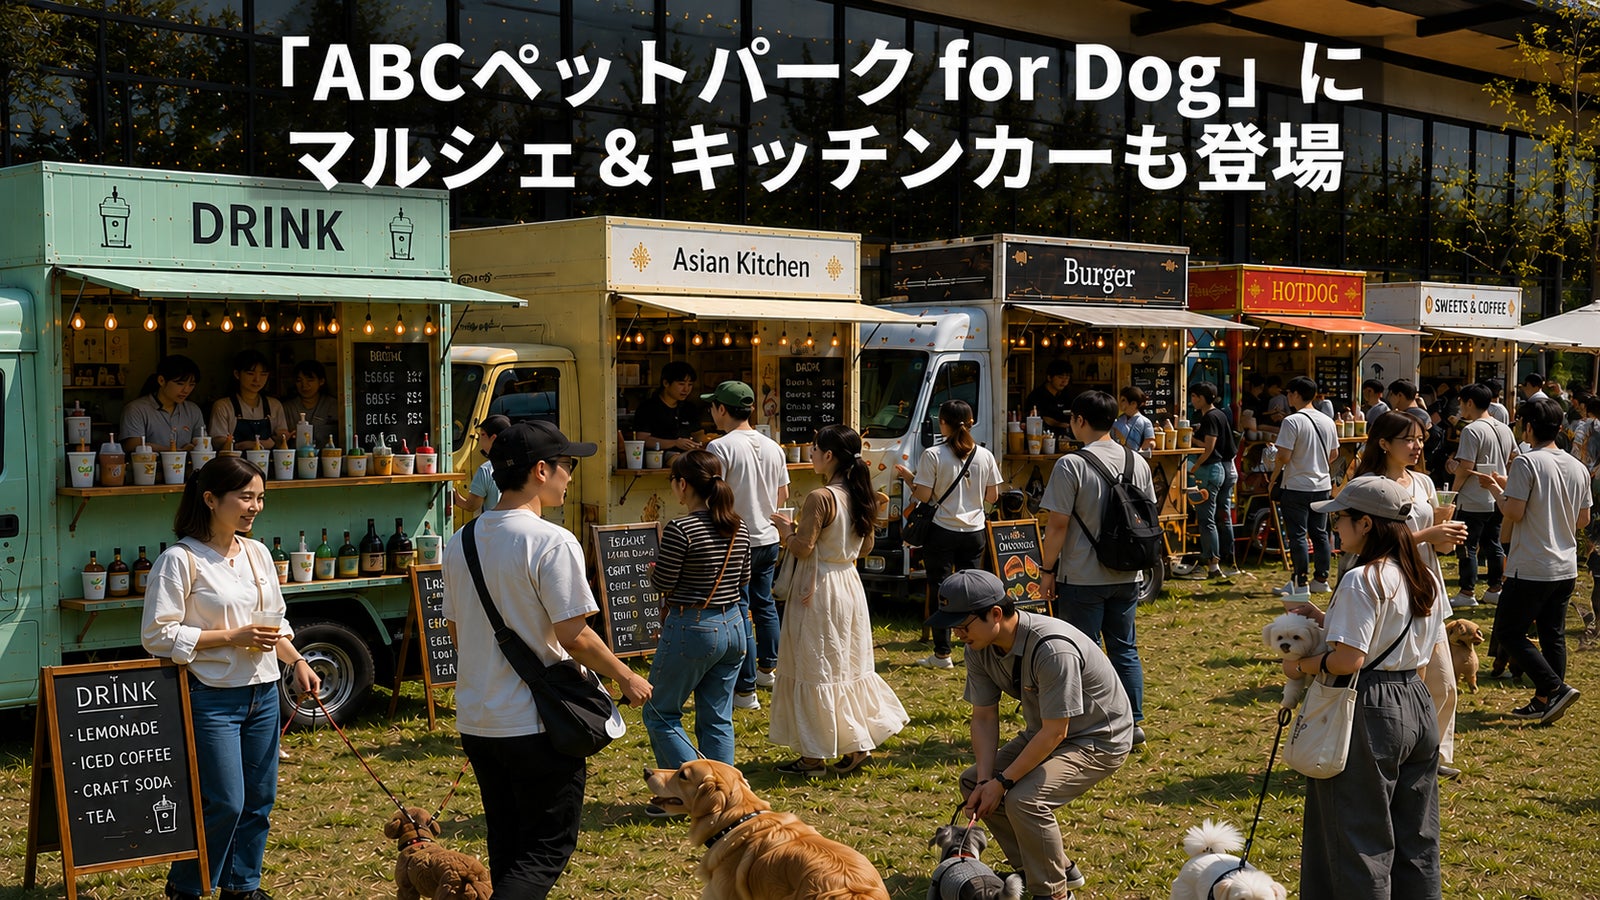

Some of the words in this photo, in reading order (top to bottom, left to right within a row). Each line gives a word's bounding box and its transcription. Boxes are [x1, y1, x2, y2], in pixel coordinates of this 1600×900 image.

[192, 202, 345, 252] DRINK
[673, 246, 729, 274] Asian
[737, 251, 810, 278] Kitchen
[1063, 257, 1136, 294] Burger
[1272, 280, 1339, 304] HOTDOG
[1434, 298, 1468, 314] SWEETS
[1469, 300, 1476, 314] &
[1478, 300, 1507, 315] COFFEE
[76, 680, 158, 708] DRINK
[77, 720, 159, 742] LEMONADE
[80, 753, 115, 770] ICED
[119, 747, 172, 766] COFFEE
[83, 779, 129, 798] CRAFT
[135, 775, 173, 792] SODA
[86, 808, 116, 825] TEA
